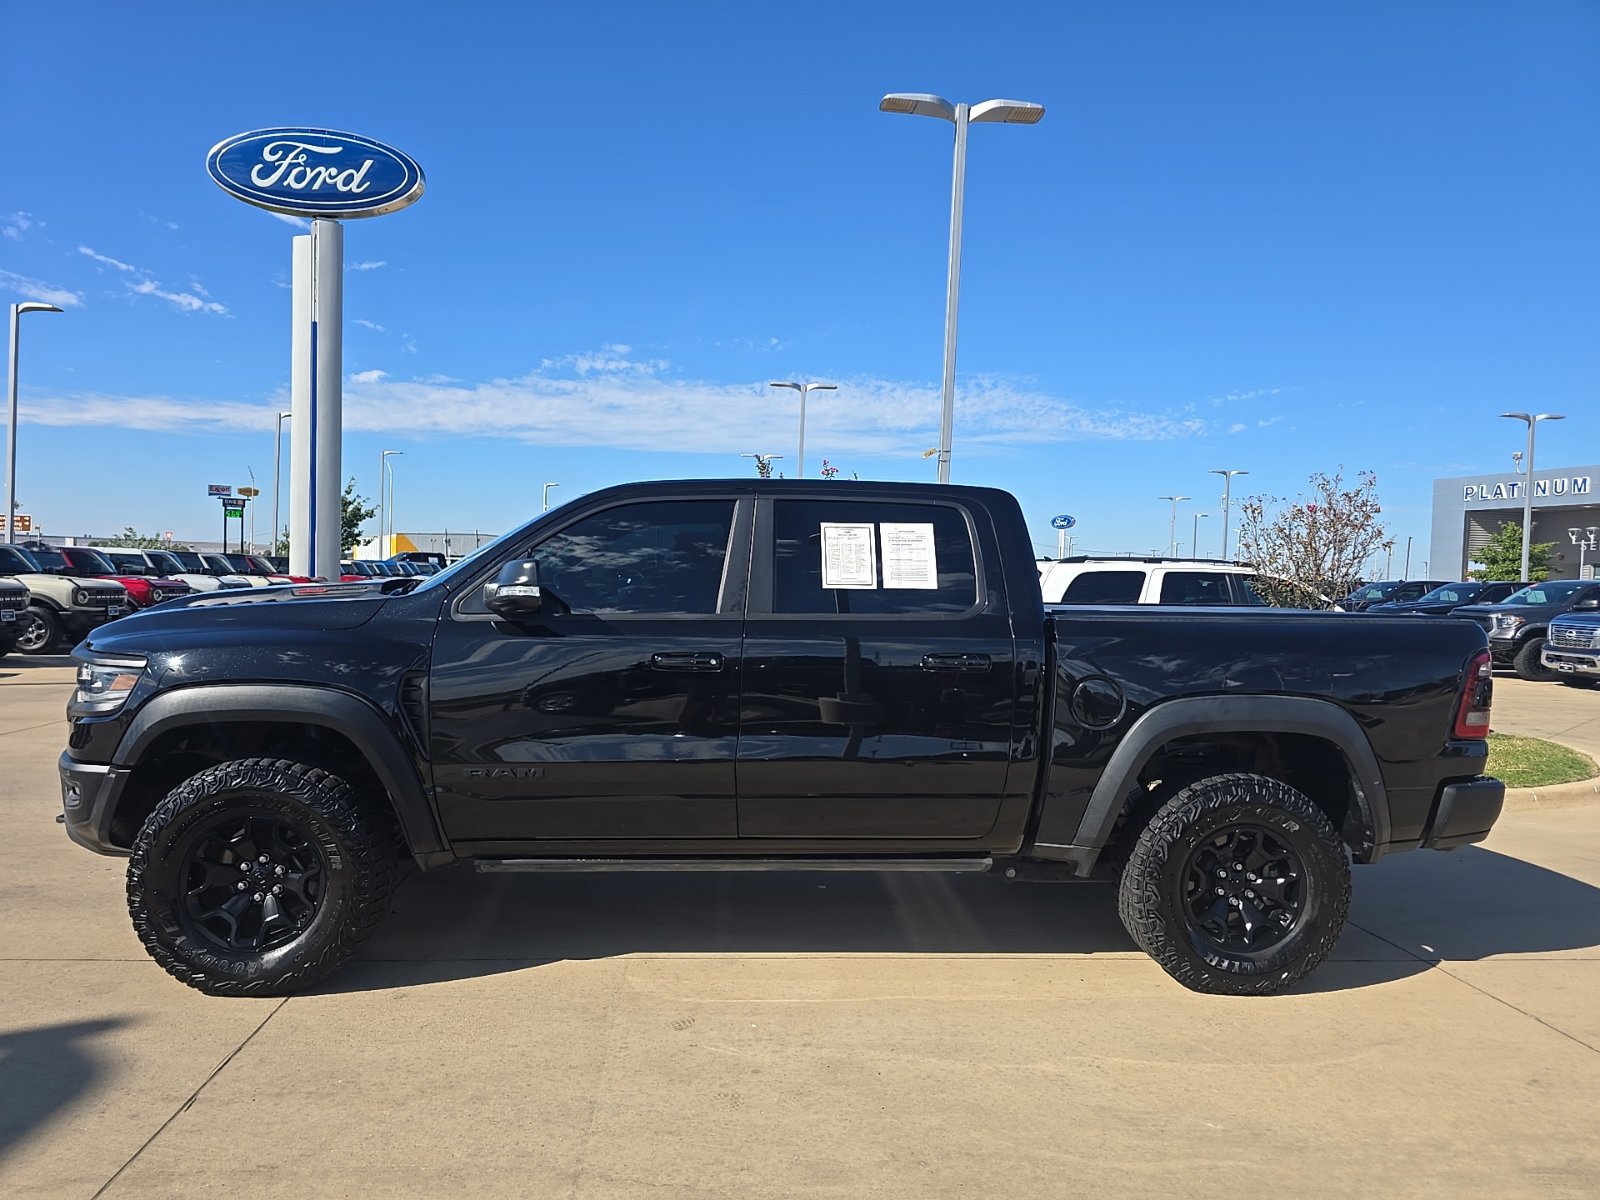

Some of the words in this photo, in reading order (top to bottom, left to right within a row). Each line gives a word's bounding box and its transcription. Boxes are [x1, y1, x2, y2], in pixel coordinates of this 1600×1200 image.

[251, 141, 374, 194] Ford
[1464, 476, 1591, 501] PLATINUM
[1054, 516, 1068, 526] Ford
[463, 767, 545, 779] RAM
